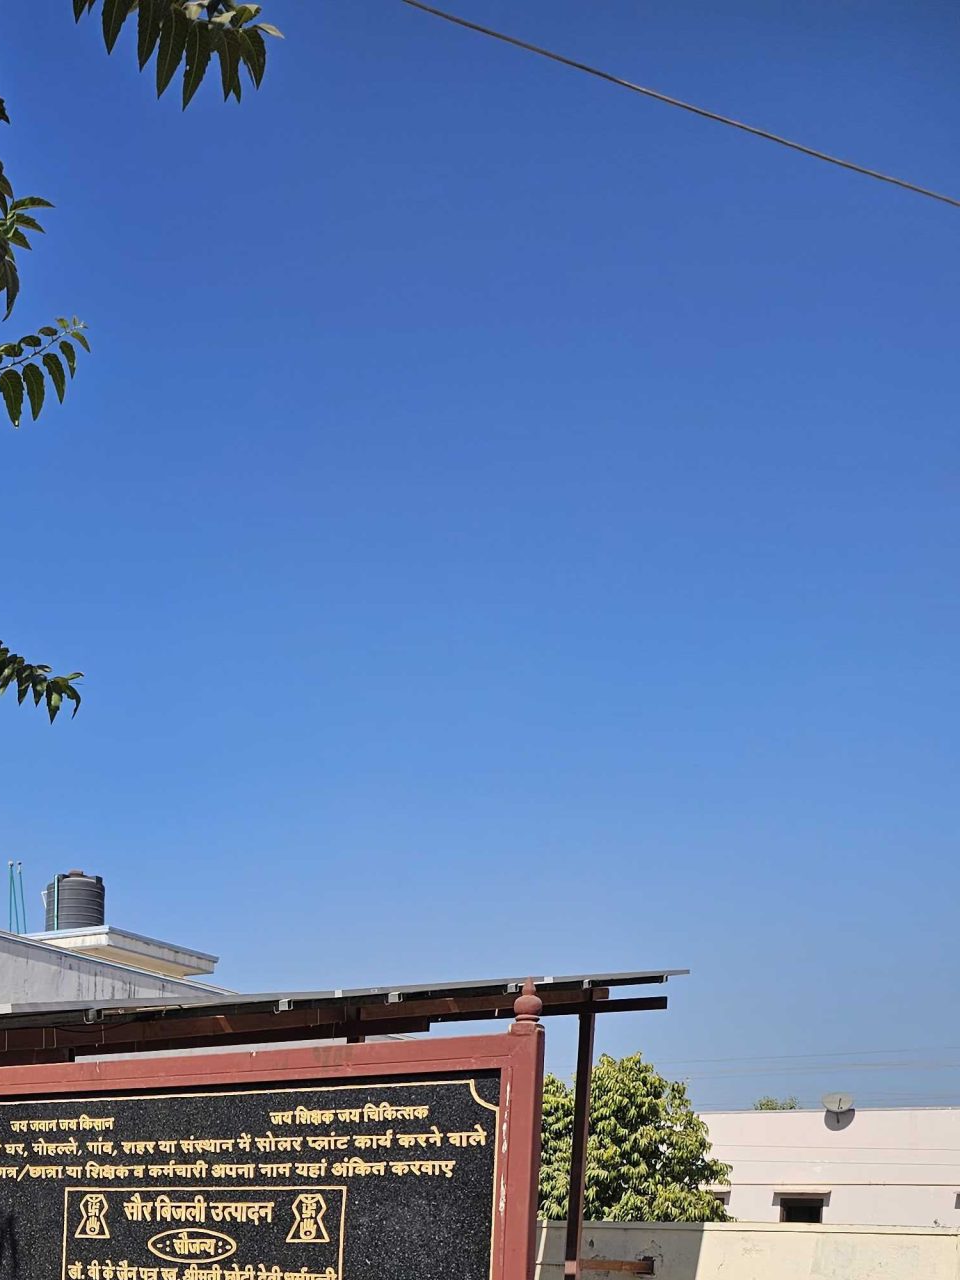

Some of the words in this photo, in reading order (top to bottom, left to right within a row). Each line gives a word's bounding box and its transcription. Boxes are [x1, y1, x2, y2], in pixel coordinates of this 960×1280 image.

[10, 1118, 27, 1132] जय
[29, 1118, 57, 1132] जवान
[59, 1118, 78, 1131] जय
[79, 1114, 114, 1130] किसान
[269, 1110, 292, 1125] जय
[295, 1106, 334, 1125] शिक्षक
[337, 1108, 360, 1122] जय
[363, 1102, 429, 1122] चिकित्सक
[121, 1141, 155, 1154] शहर
[158, 1141, 177, 1153] या
[180, 1136, 233, 1153] संस्थान
[238, 1133, 251, 1151] में
[256, 1131, 302, 1151] सोलर
[307, 1132, 350, 1150] प्लांट
[353, 1130, 393, 1149] कार्य
[397, 1126, 443, 1148] करने
[447, 1125, 486, 1146] वाले
[66, 1166, 81, 1178] या
[86, 1161, 129, 1180] शिक्षक
[134, 1166, 144, 1178] व
[149, 1160, 208, 1178] कर्मचारी
[211, 1163, 255, 1178] अपना
[259, 1163, 291, 1178] नाम
[295, 1157, 326, 1177] यहां
[331, 1157, 387, 1177] अंकित
[390, 1160, 456, 1177] करवाए
[123, 1193, 153, 1221] सौर
[156, 1193, 205, 1222] बिजली
[210, 1201, 274, 1225] उत्पादन
[88, 1261, 100, 1280] वी
[103, 1260, 115, 1280] के
